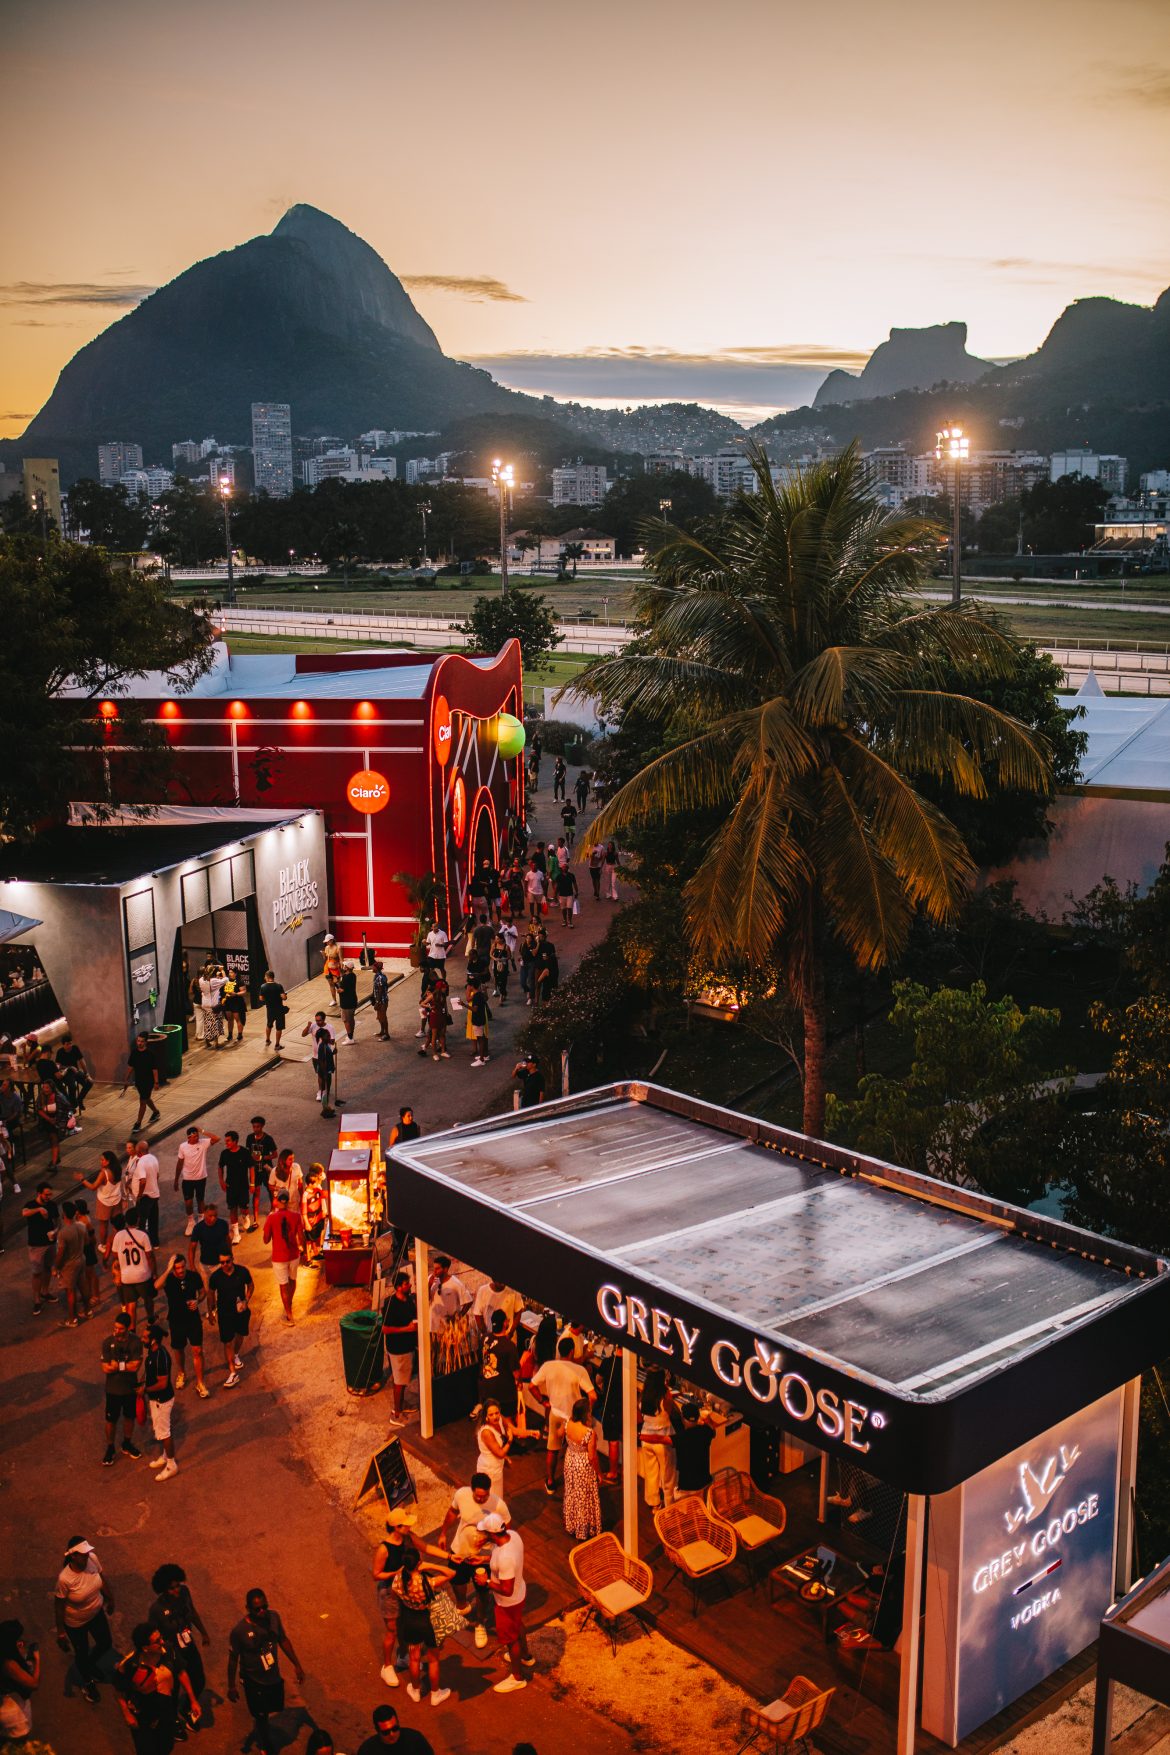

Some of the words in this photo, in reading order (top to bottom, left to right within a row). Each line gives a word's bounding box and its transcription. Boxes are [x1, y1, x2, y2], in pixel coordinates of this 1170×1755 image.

[351, 787, 381, 798] Claro
[279, 858, 310, 896] BLACK
[272, 881, 319, 932] PRINCESS
[226, 954, 249, 963] BLACK
[122, 1247, 141, 1266] 10
[596, 1284, 700, 1366] GREY
[972, 1541, 1027, 1593] GREY
[1031, 1493, 1099, 1556] GOOSE
[1010, 1588, 1062, 1630] VODKA
